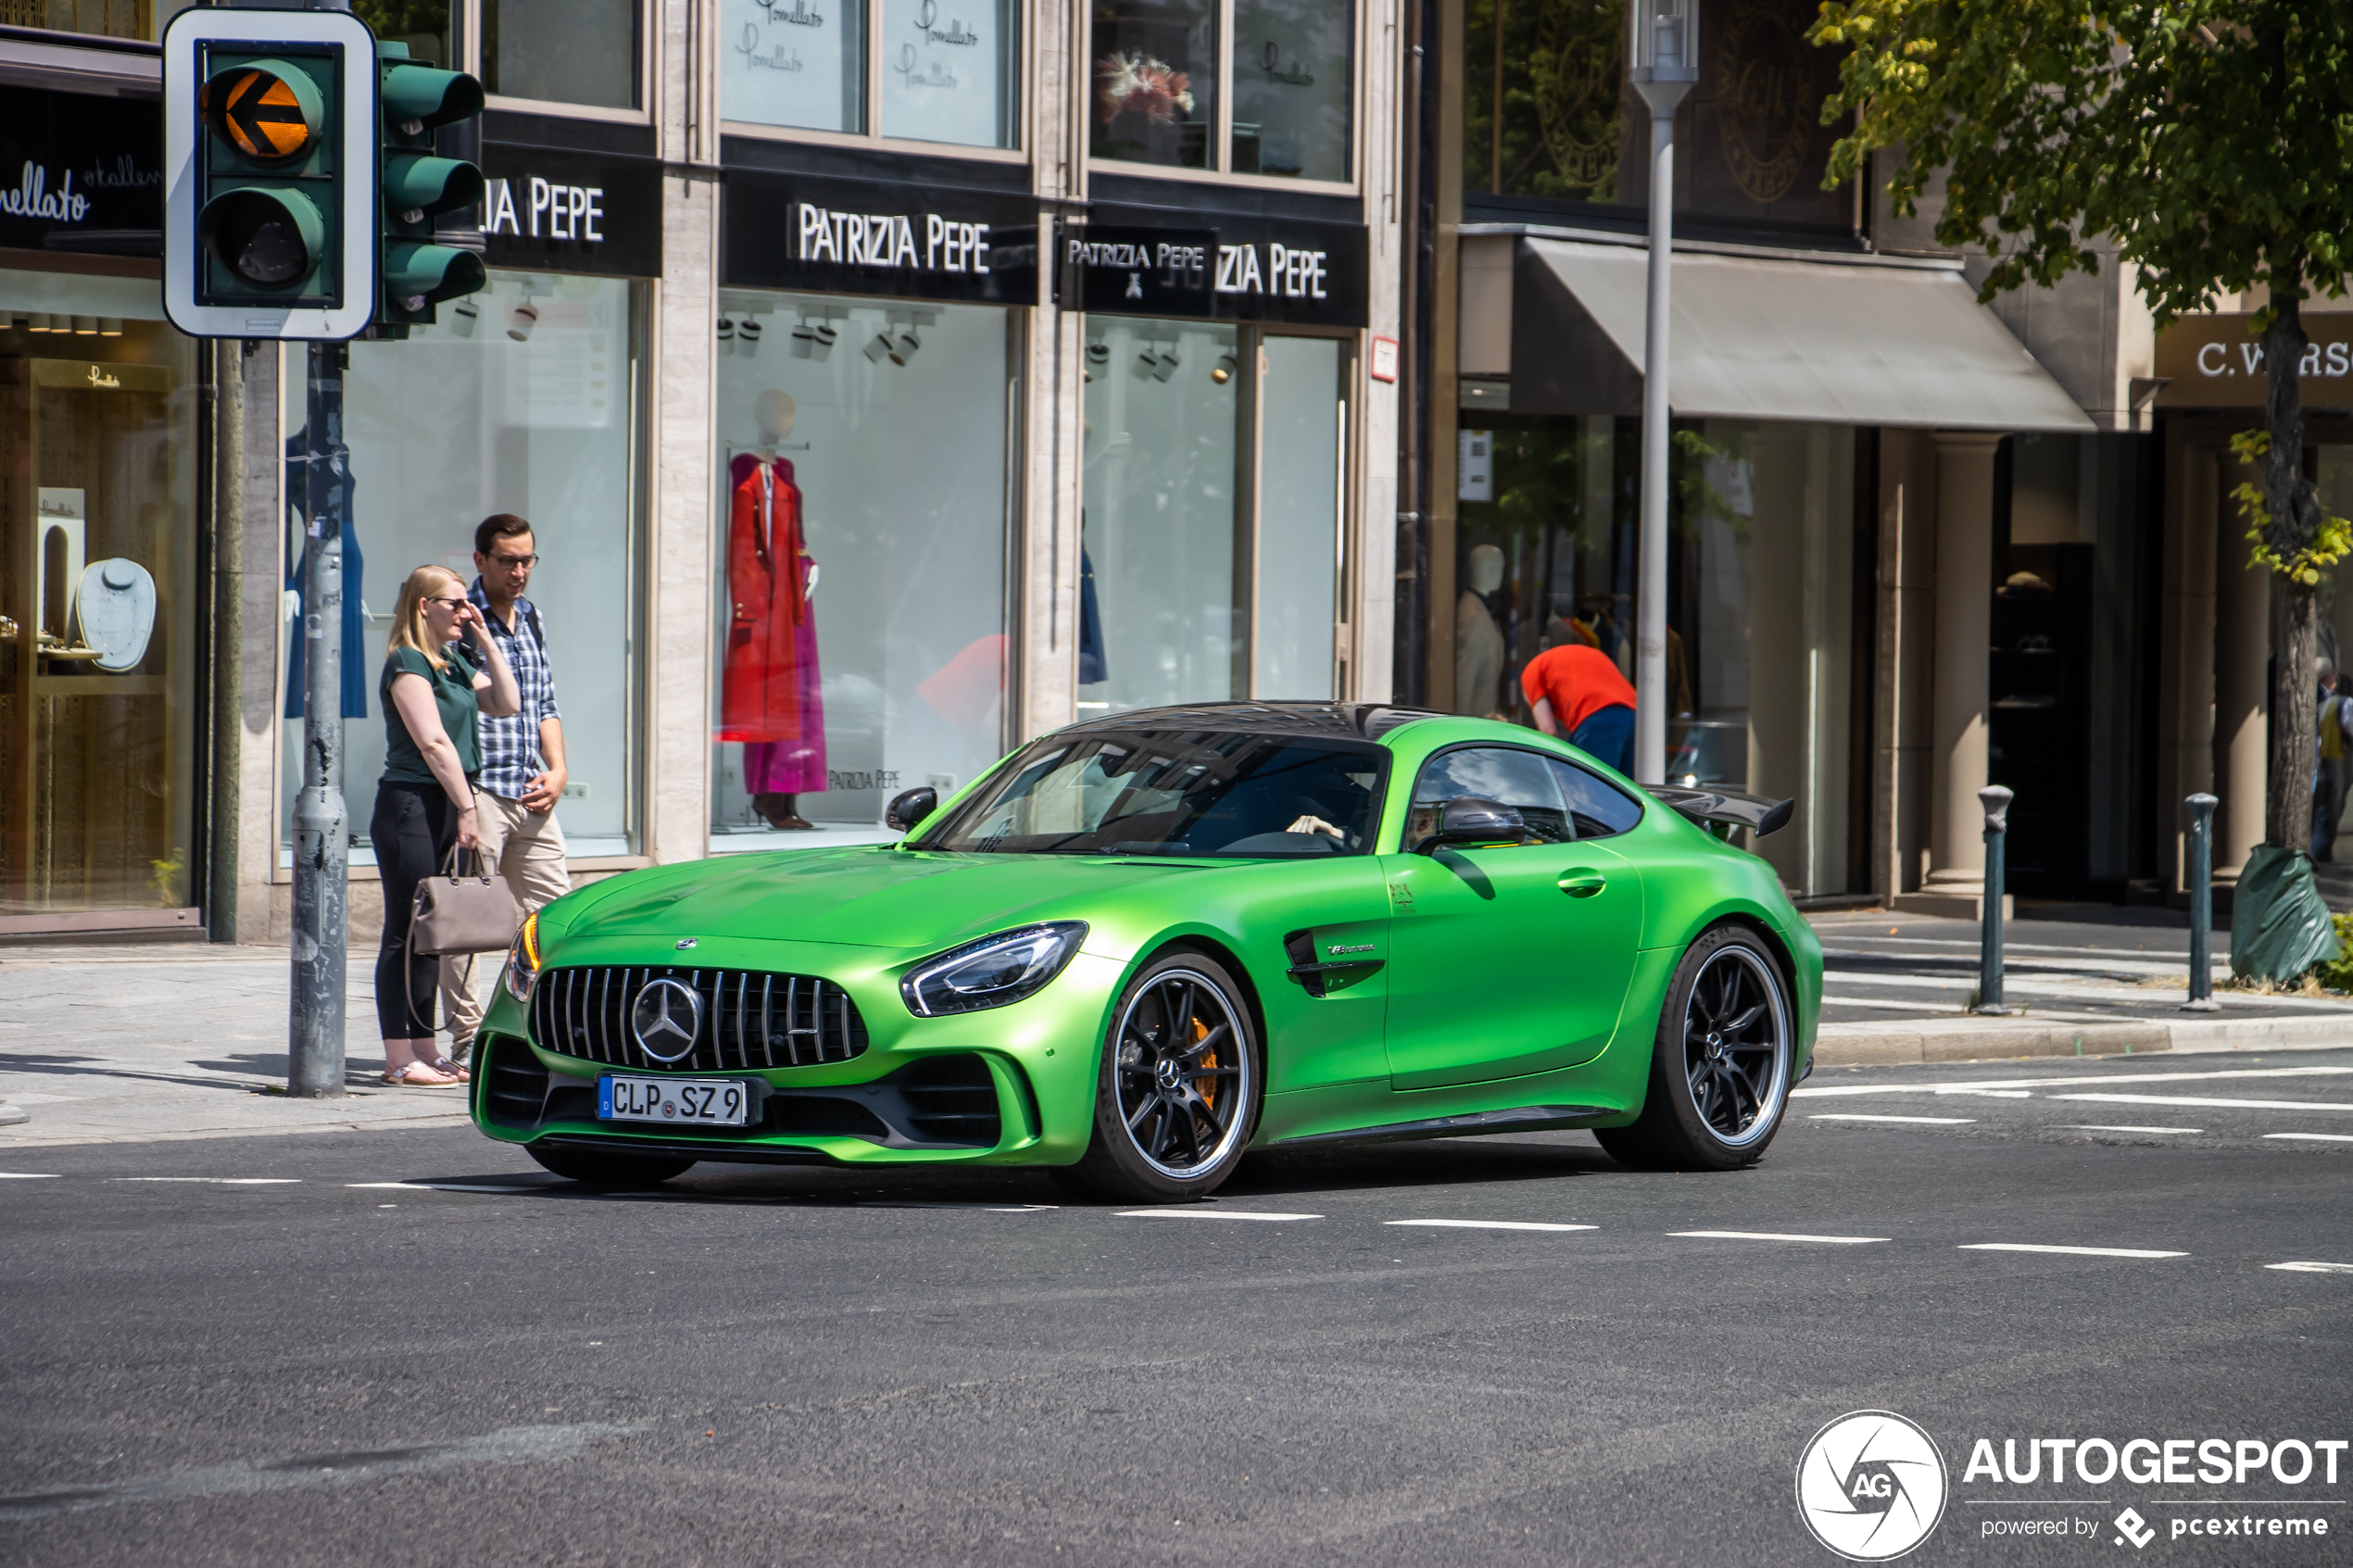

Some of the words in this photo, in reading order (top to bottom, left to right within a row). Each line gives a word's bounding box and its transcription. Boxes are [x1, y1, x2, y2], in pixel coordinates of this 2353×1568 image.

[478, 178, 521, 236] IA
[531, 177, 604, 243] PEPE
[799, 203, 919, 270] PATRIZIA
[927, 214, 990, 275] PEPE
[1068, 239, 1151, 269] PATRIZIA
[1157, 243, 1205, 271] PEPE
[1270, 243, 1327, 299] PEPE
[828, 770, 874, 790] PATRIZIA
[875, 769, 900, 789] PEPE
[603, 1100, 610, 1110] D
[614, 1083, 661, 1115] CLP
[680, 1086, 716, 1118] SZ
[724, 1087, 740, 1119] 9
